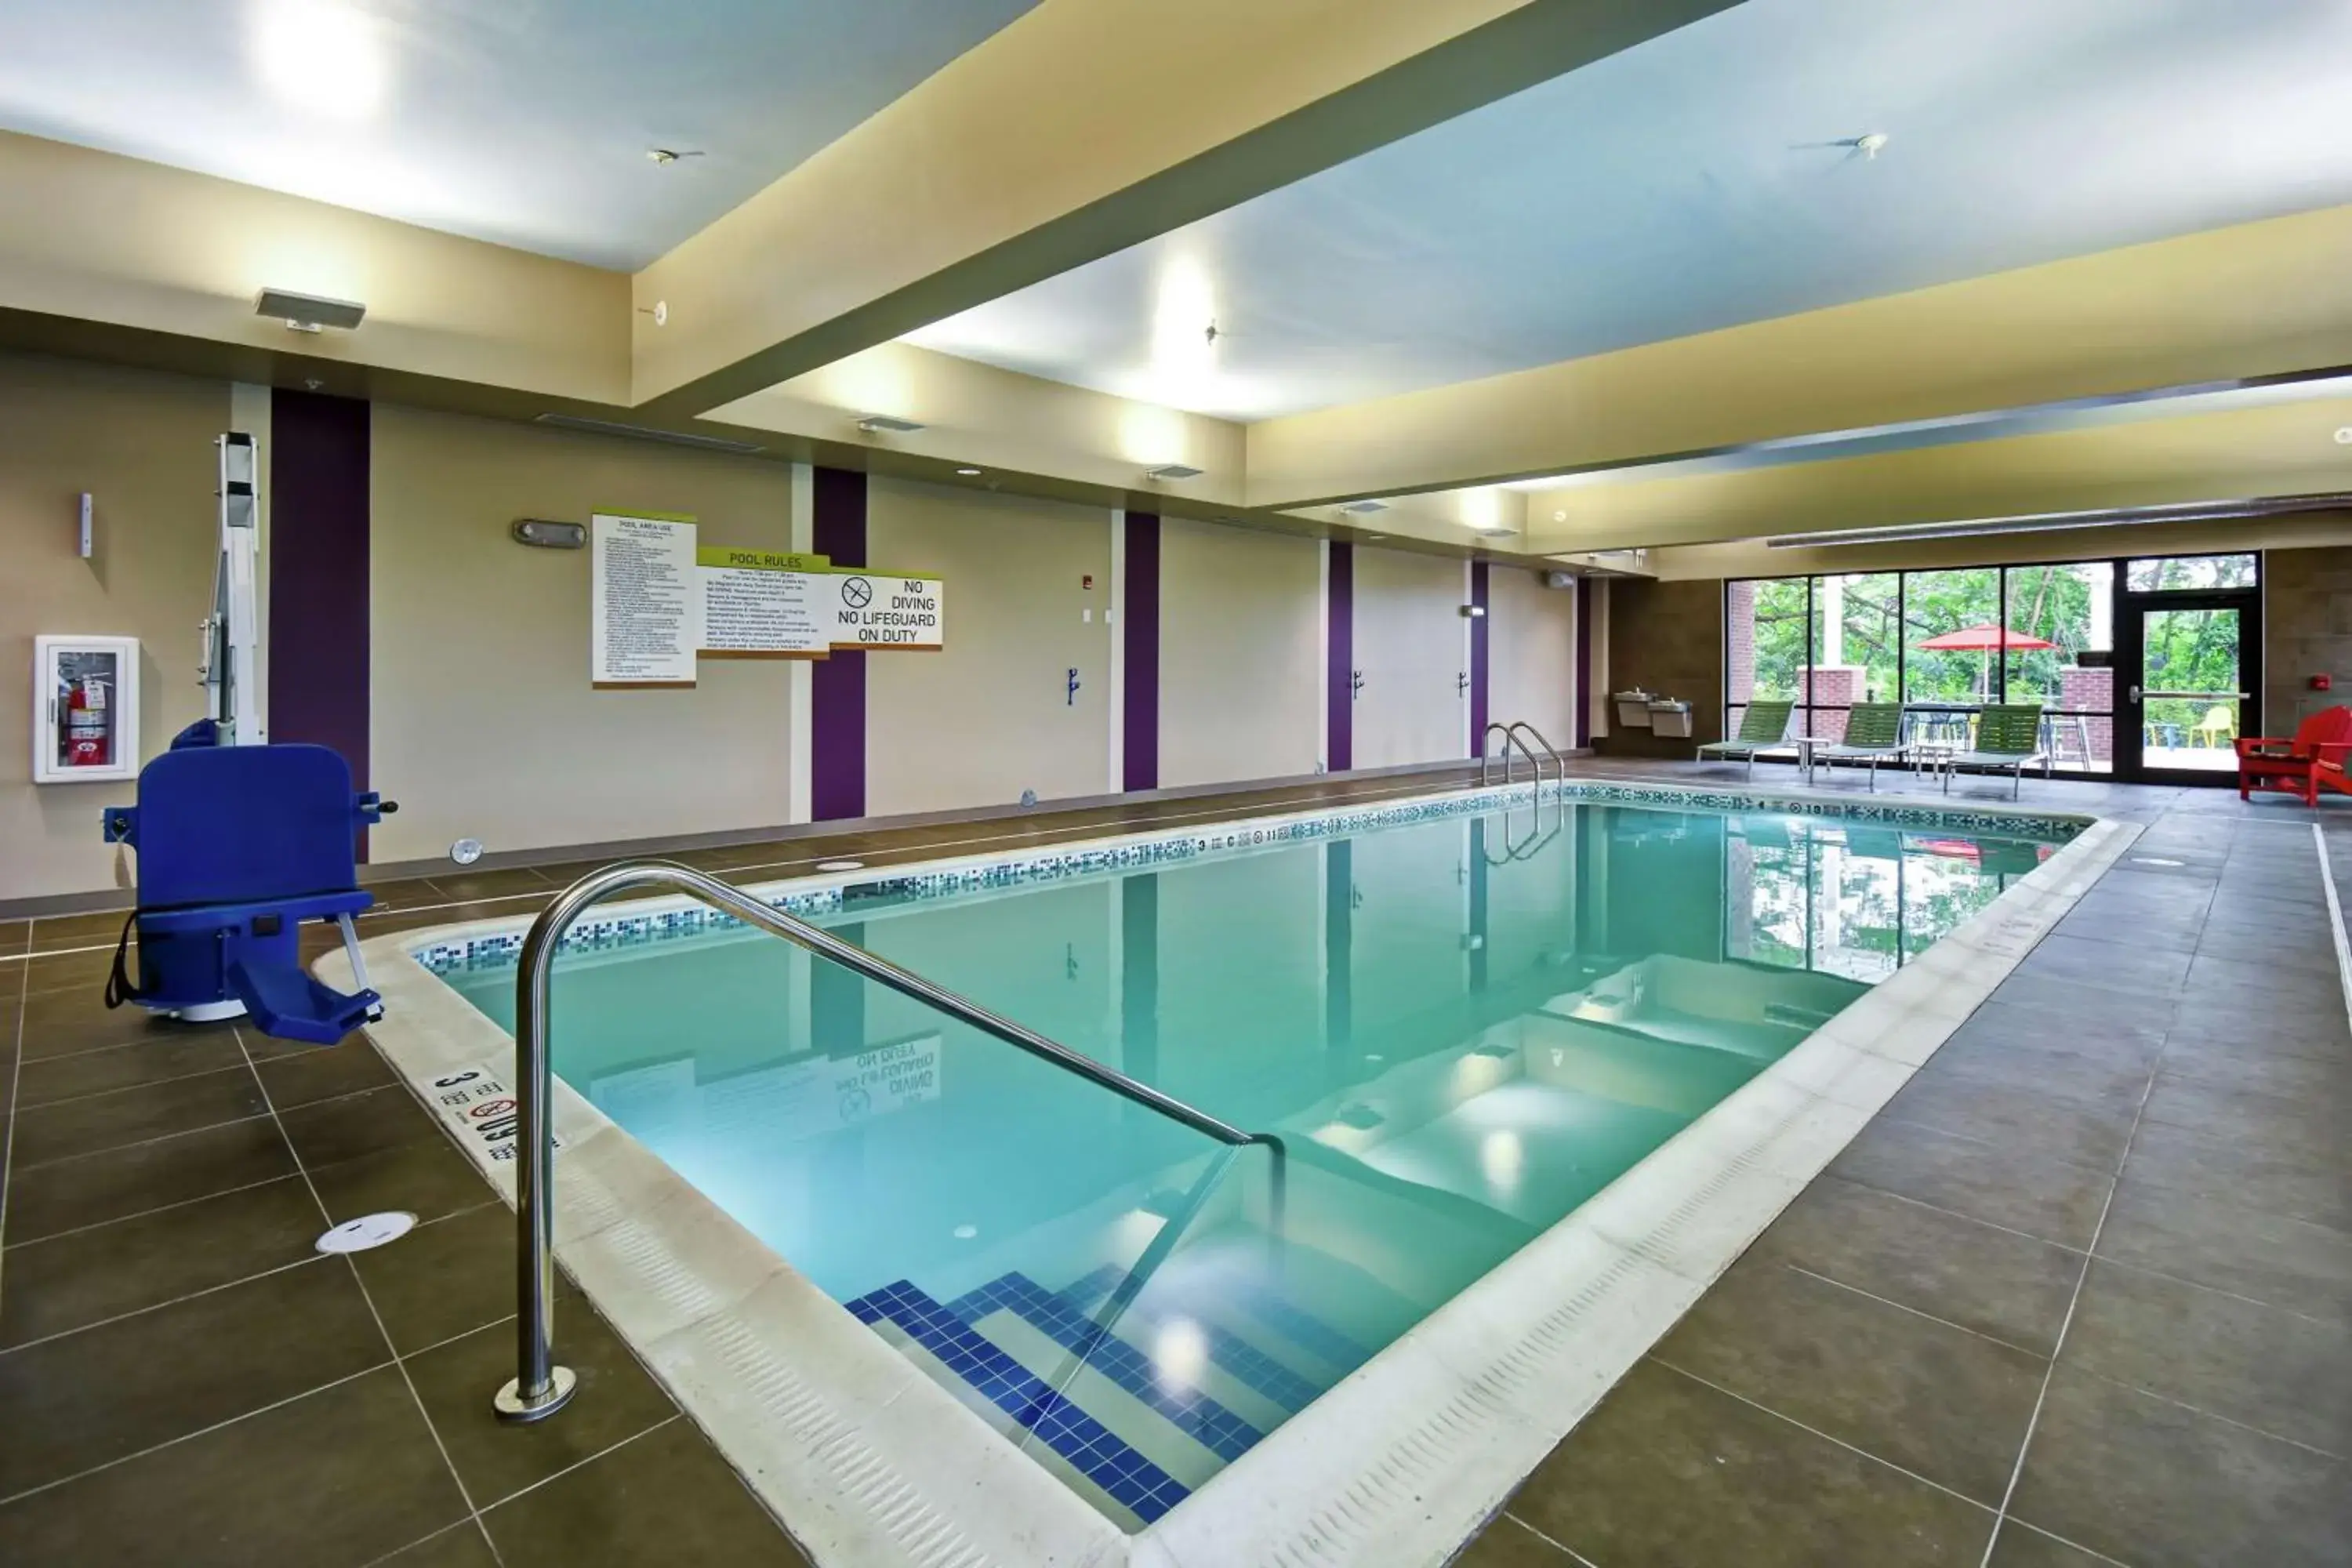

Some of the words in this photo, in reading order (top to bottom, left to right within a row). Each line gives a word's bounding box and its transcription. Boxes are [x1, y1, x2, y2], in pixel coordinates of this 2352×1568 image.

[730, 553, 760, 564] POOL
[764, 555, 802, 568] RULES
[904, 580, 923, 593] NO
[891, 596, 935, 611] DIVING
[838, 611, 858, 624] NO
[863, 612, 935, 626] LIFEGUARD
[858, 629, 877, 641] ON
[883, 629, 917, 642] DUTY
[435, 1072, 480, 1087] 3
